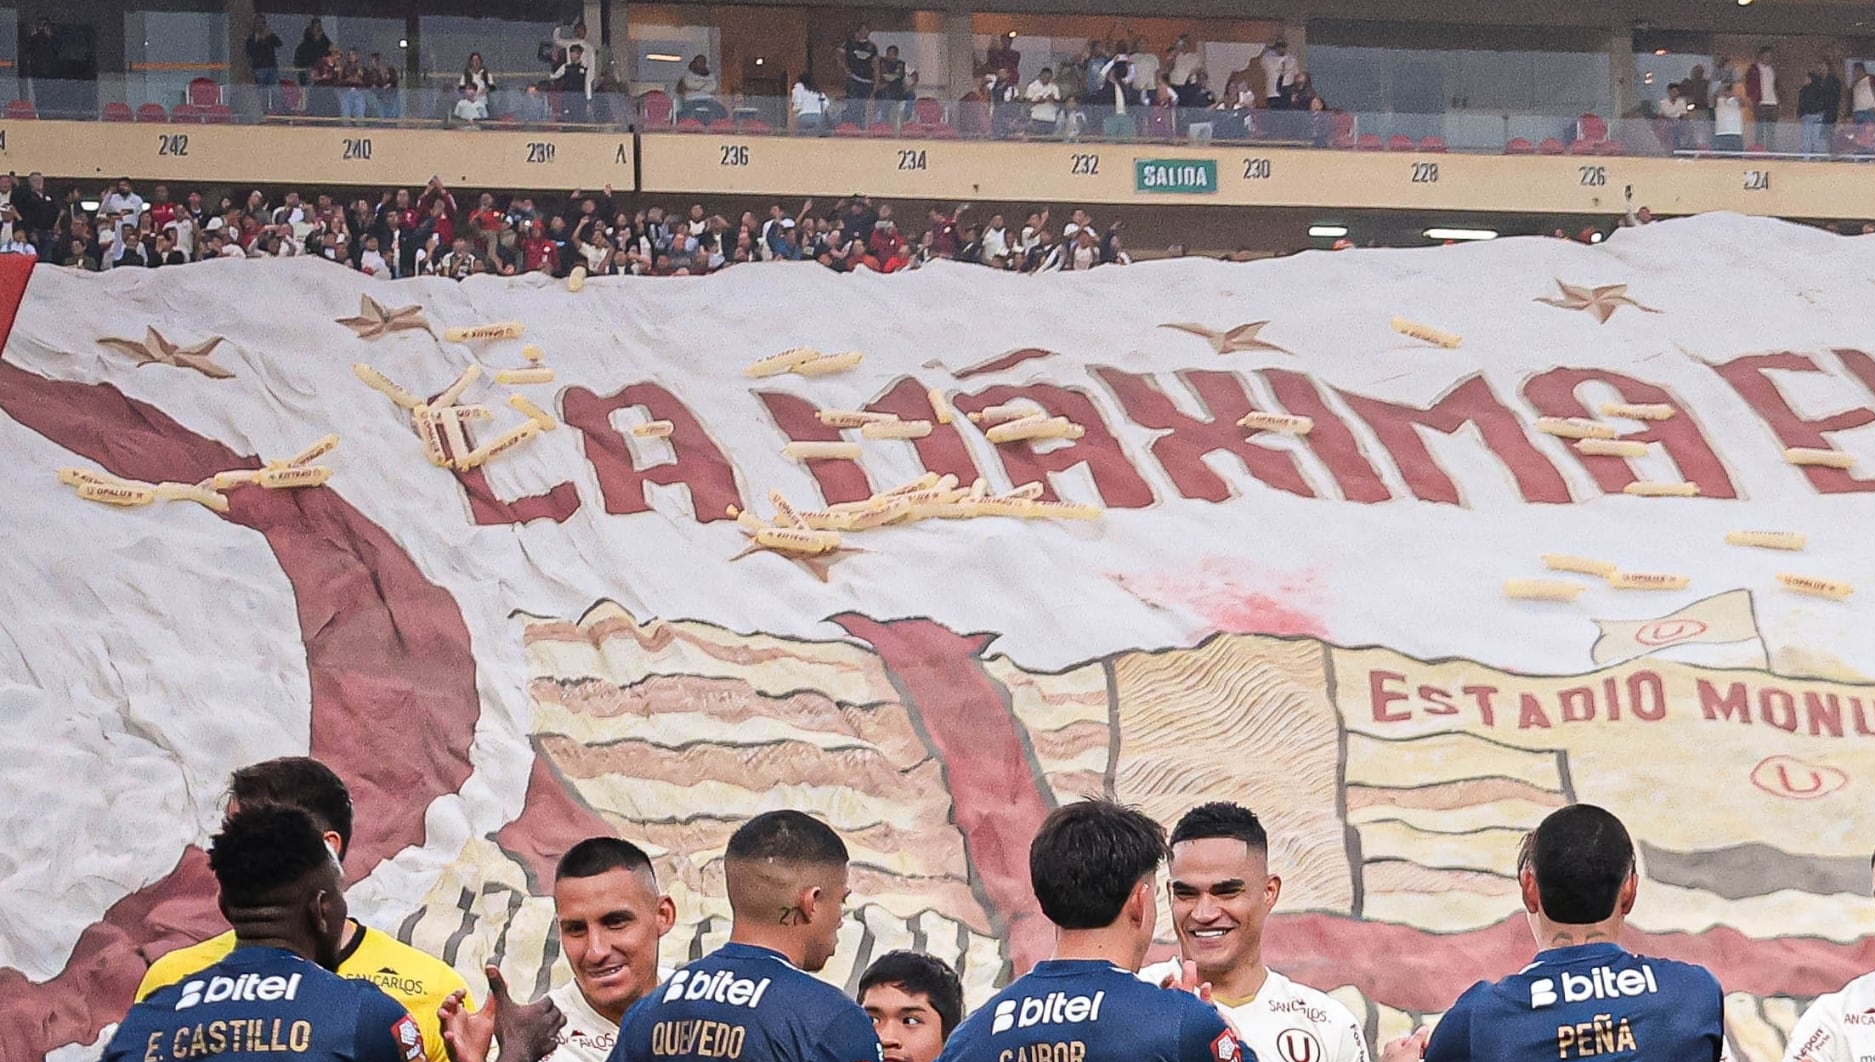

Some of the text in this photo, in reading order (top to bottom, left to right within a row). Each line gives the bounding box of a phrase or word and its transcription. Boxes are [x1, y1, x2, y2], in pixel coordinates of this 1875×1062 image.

[159, 134, 188, 156] 242
[343, 138, 372, 160] 240
[720, 144, 749, 166] 236
[898, 150, 927, 171] 234
[1070, 154, 1099, 174] 232
[1242, 158, 1271, 179] 230
[1144, 162, 1207, 187] SALIDA
[1411, 162, 1438, 183] 228
[1579, 166, 1606, 187] 226
[96, 487, 133, 499] OPALUX
[1369, 668, 1666, 730] ESTADIO
[203, 972, 303, 1004] bitel
[683, 969, 772, 1009] bitel
[1562, 965, 1658, 1003] bitel
[1017, 990, 1106, 1028] bitel
[172, 1017, 313, 1060] CASTILLO
[652, 1018, 746, 1060] QUEVEDO
[1557, 1014, 1637, 1060] PEÑA
